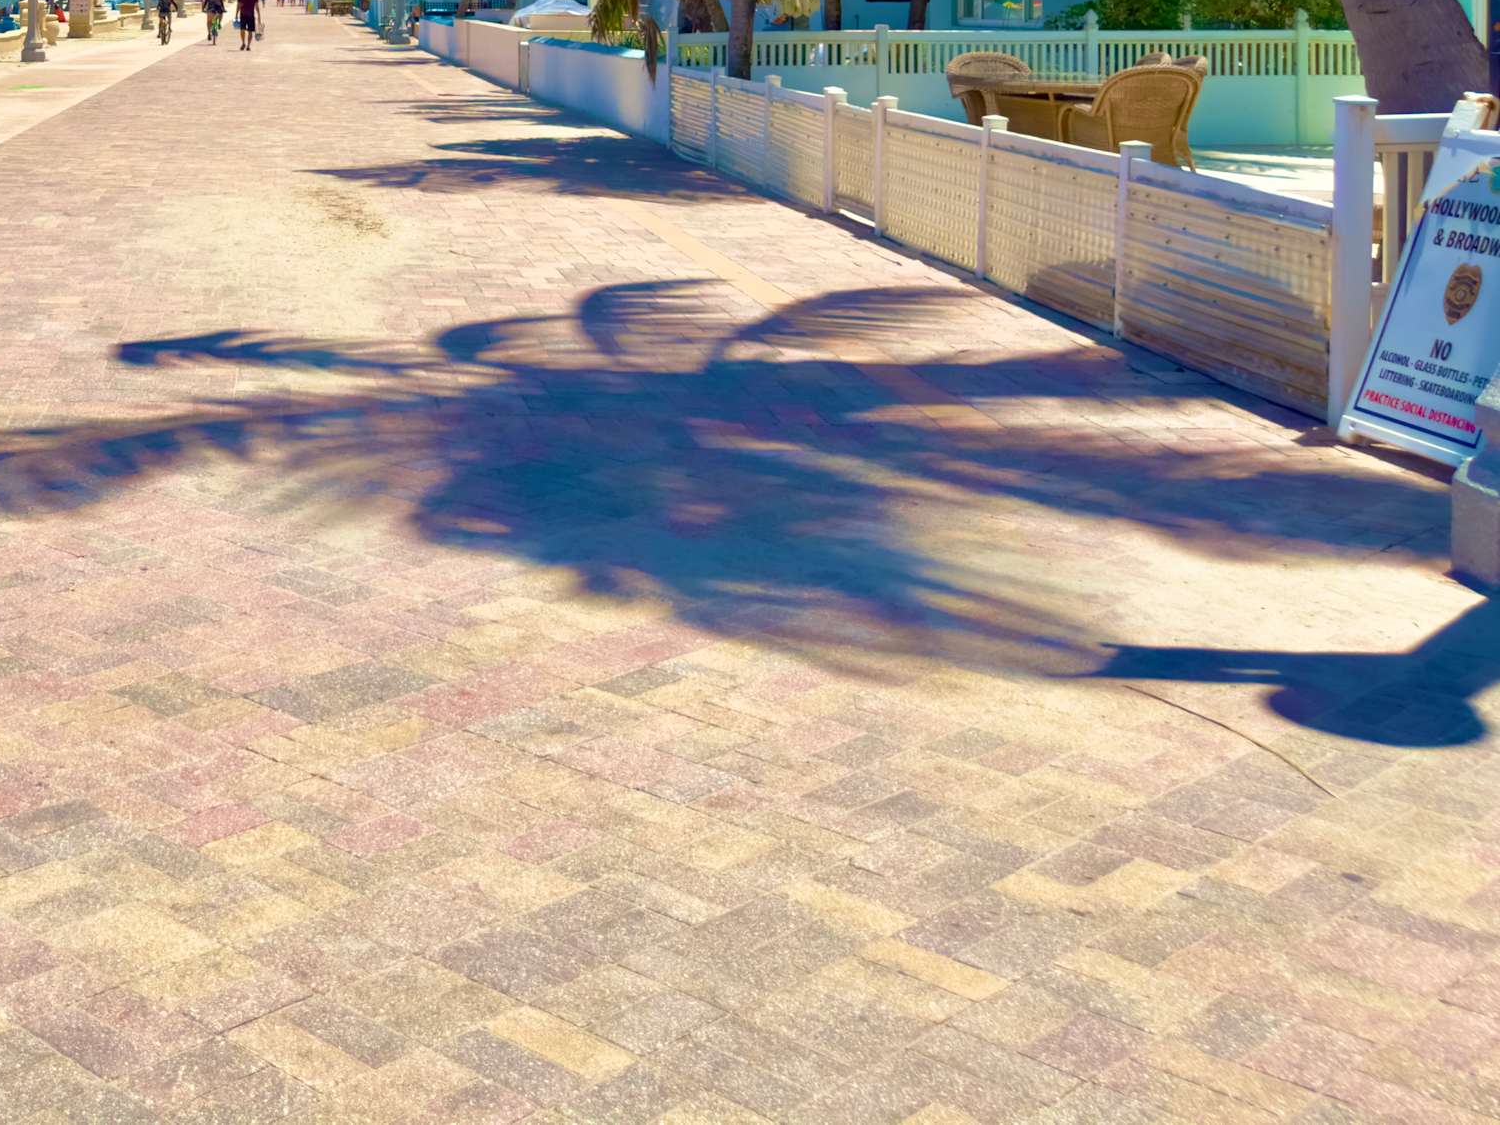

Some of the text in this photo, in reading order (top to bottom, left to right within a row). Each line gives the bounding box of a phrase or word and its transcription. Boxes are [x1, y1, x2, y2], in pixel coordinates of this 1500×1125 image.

[1433, 228, 1500, 258] & BROADW
[1429, 339, 1452, 361] NO
[1379, 368, 1415, 387] LITTERING
[1380, 350, 1411, 368] ALCOHOL
[1414, 360, 1438, 375] GLASS
[1438, 366, 1469, 383] BOTTLES
[1364, 389, 1476, 434] PRACTICE SOCIAL DISTANCING
